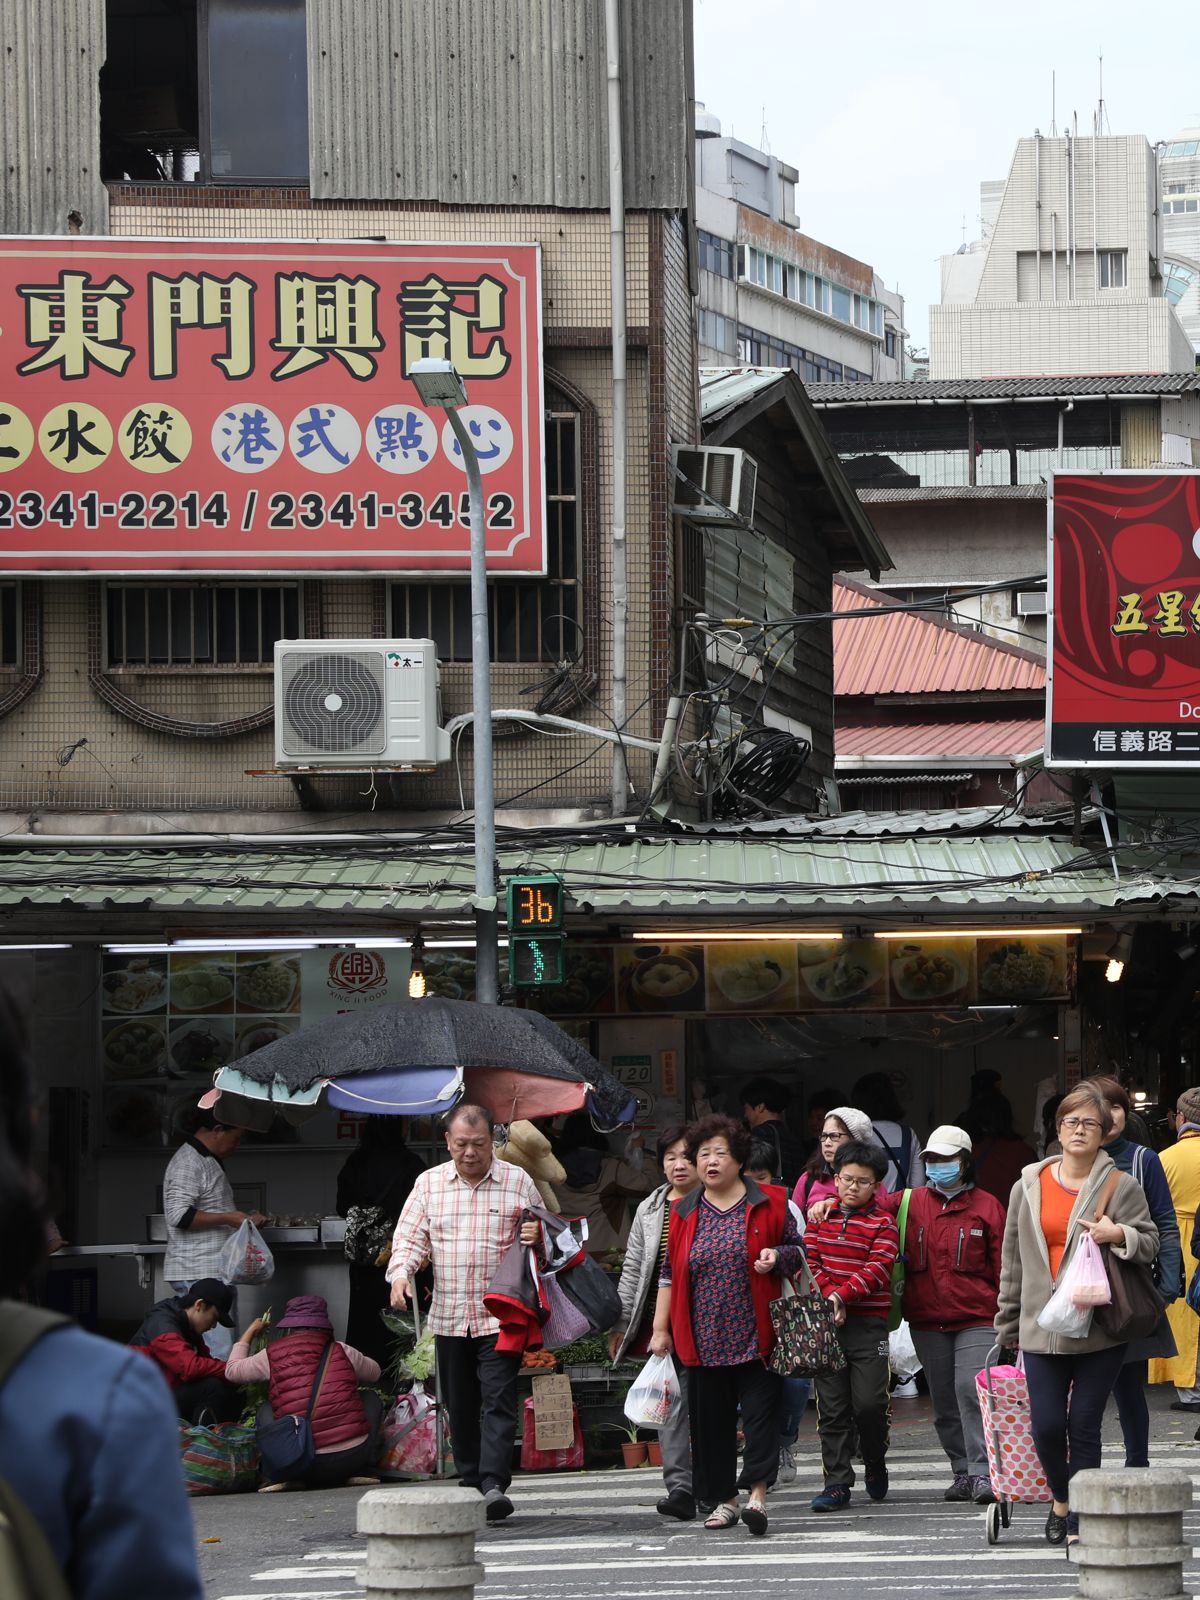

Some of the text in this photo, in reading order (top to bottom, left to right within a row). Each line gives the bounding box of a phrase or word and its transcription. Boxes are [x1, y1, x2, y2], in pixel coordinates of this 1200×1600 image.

[16, 269, 511, 381] 東門興記
[222, 408, 501, 465] 港式點心
[521, 887, 553, 924] 36
[616, 1067, 649, 1080] 120
